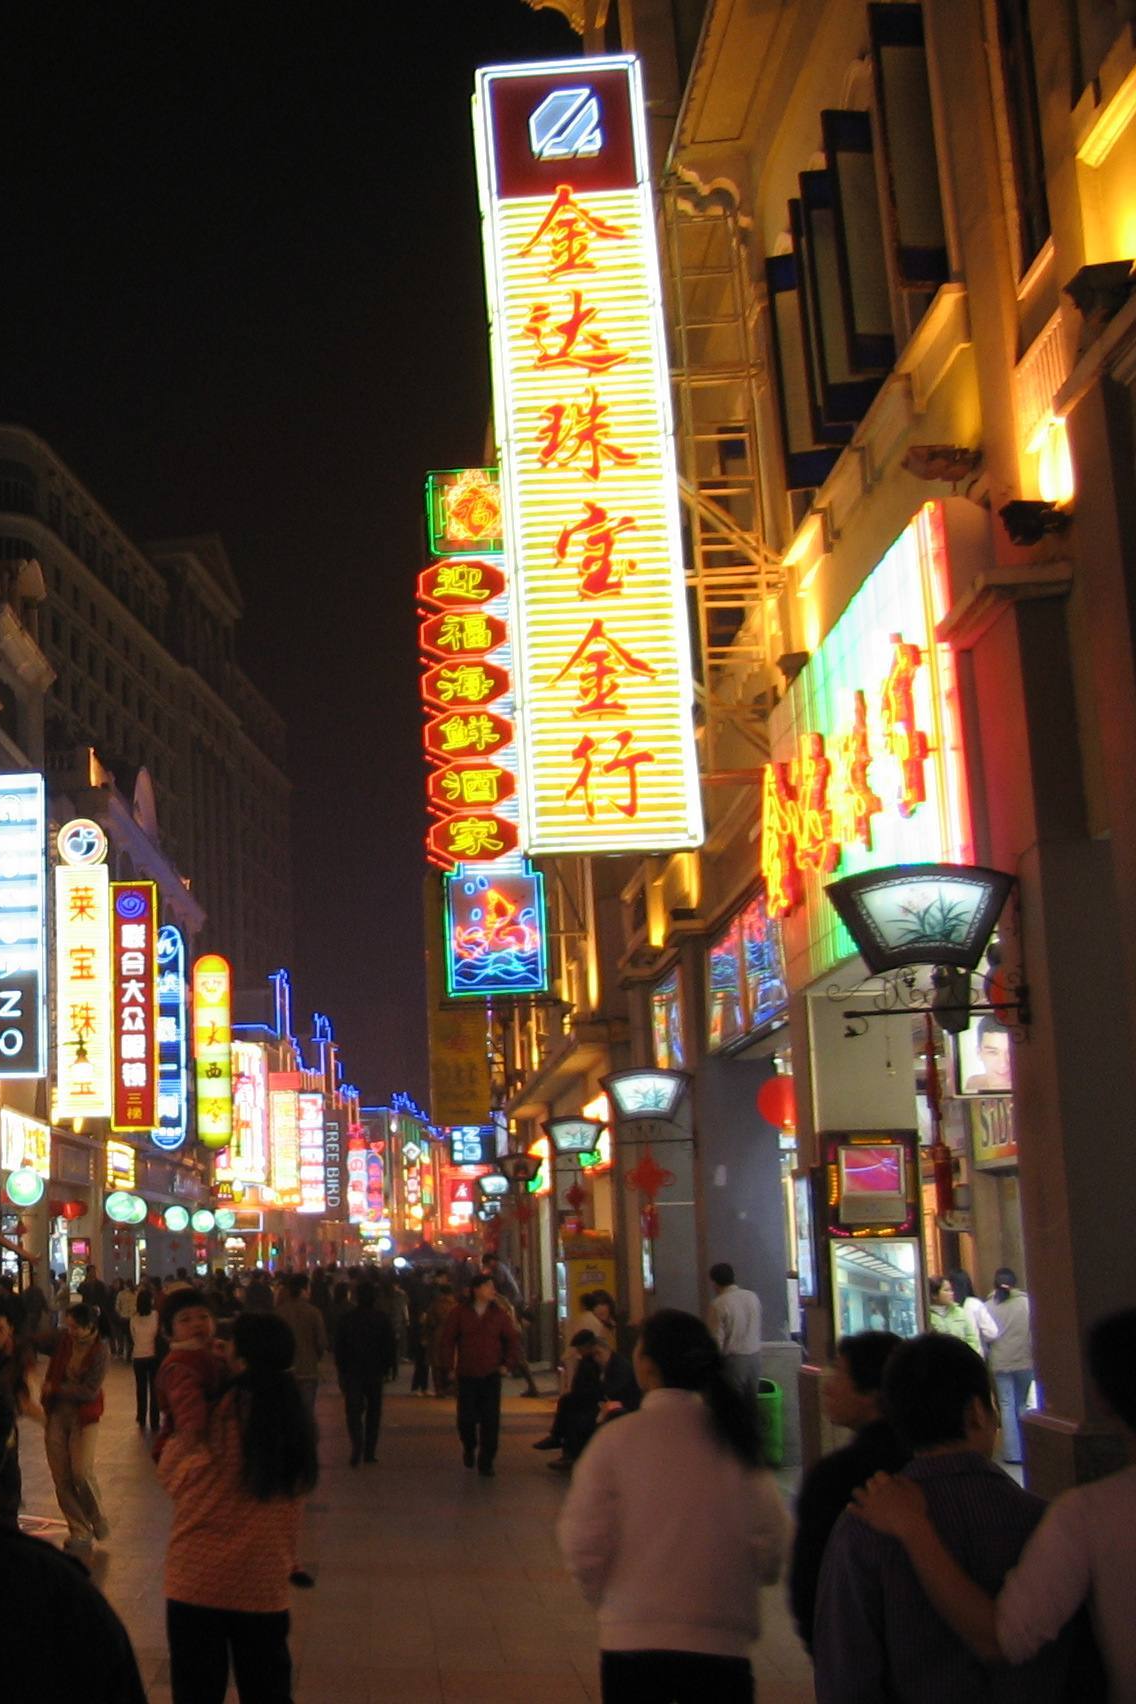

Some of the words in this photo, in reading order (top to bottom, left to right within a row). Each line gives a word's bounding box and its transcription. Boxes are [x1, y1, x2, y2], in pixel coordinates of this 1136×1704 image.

[519, 184, 661, 821] 金达珠宝金行
[325, 1121, 339, 1162] FREE
[326, 1167, 340, 1208] BIRD
